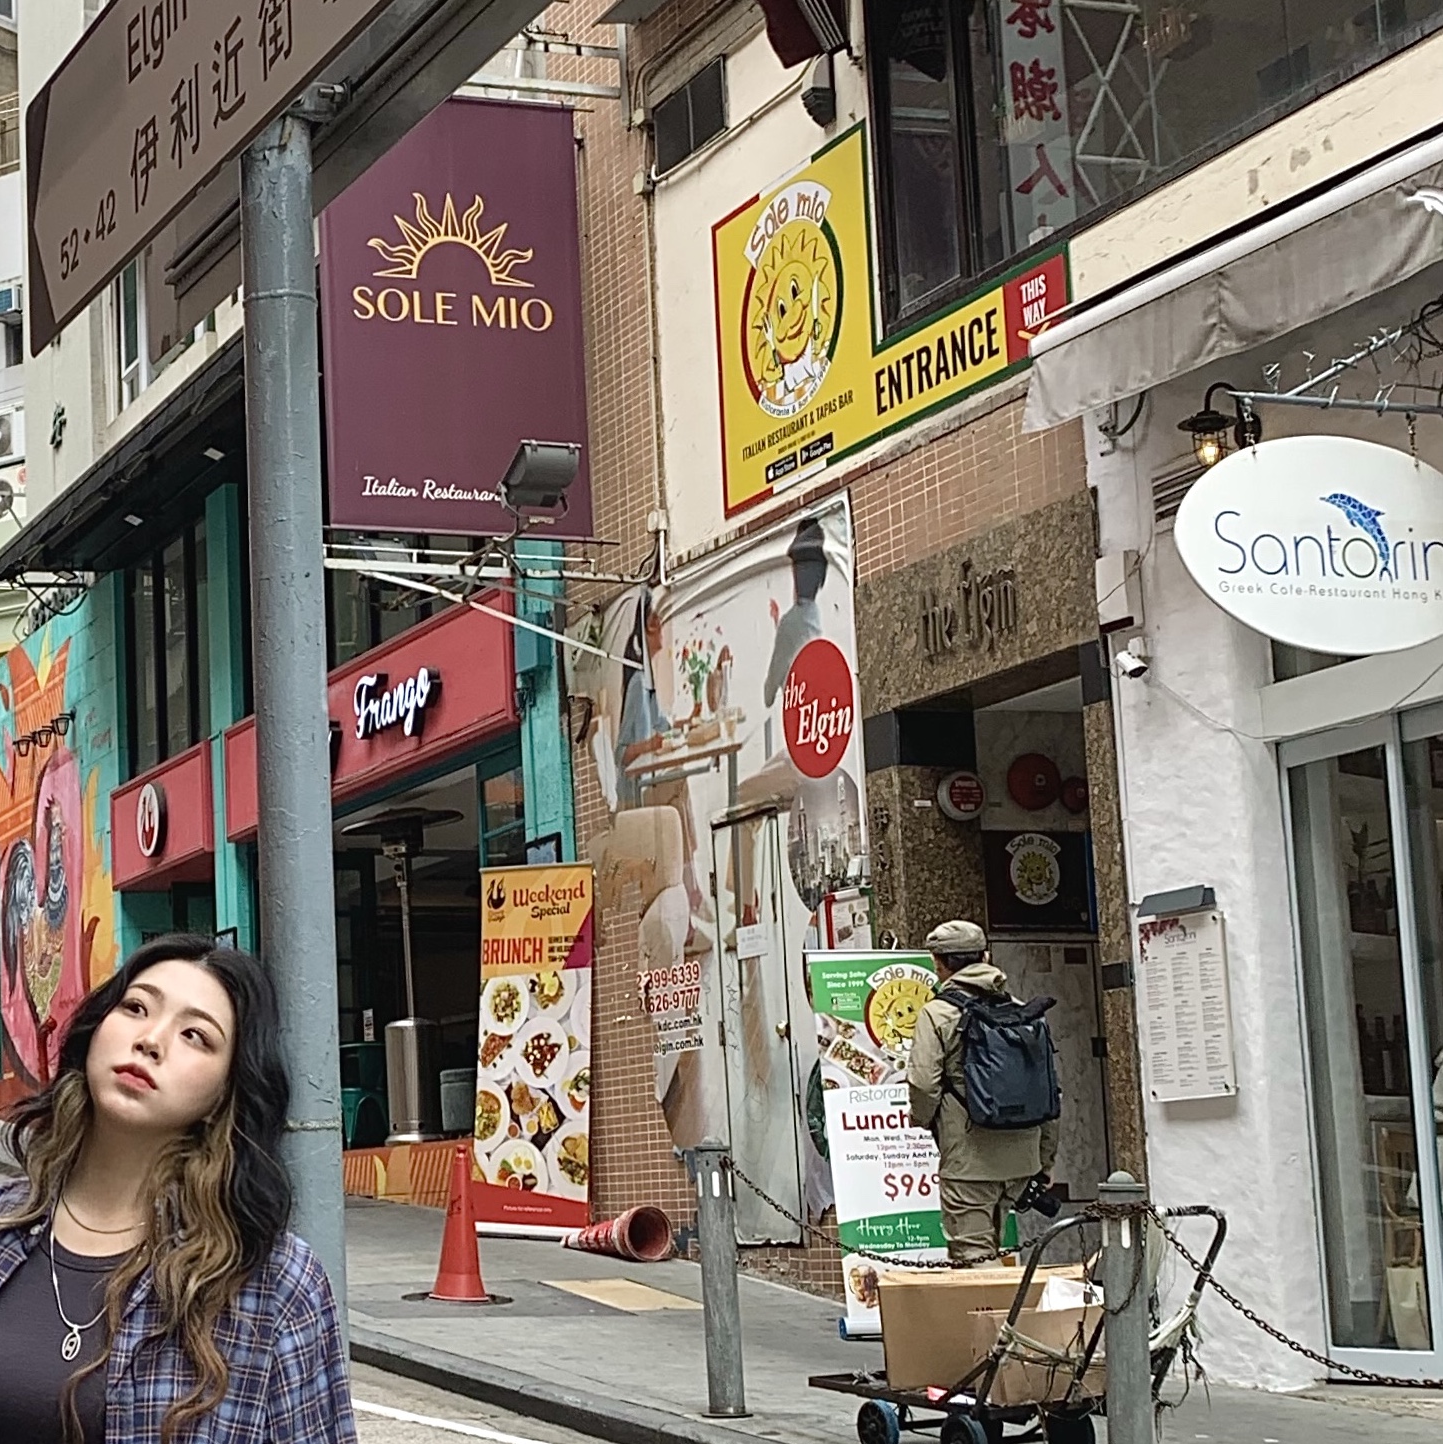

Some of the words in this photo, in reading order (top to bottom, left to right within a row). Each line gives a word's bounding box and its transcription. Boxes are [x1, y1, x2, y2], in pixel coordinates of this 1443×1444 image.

[130, 0, 293, 213] 伊利近街
[751, 198, 789, 266] Sole
[795, 191, 825, 223] mio
[1020, 274, 1046, 303] THIS
[353, 286, 458, 325] SOLE
[472, 295, 553, 331] MIO
[1023, 298, 1047, 328] WAY
[875, 308, 1000, 416] ENTRANCE
[742, 437, 766, 462] ITALIAN
[768, 414, 808, 448] RESTAURANT
[809, 410, 815, 425] &
[816, 401, 838, 421] TAPAS
[839, 389, 854, 410] BAR
[362, 476, 418, 497] Italian
[423, 480, 502, 502] Restauran
[1215, 511, 1443, 582] Santorin
[1219, 581, 1263, 594] Greek
[354, 667, 431, 741] Frango
[784, 671, 806, 710] the
[796, 698, 853, 754] Elgin
[1010, 834, 1034, 853] Sole
[513, 880, 586, 907] Weekend
[531, 902, 570, 920] Special
[483, 937, 543, 965] BRUNCH
[872, 967, 905, 988] Sole
[910, 968, 935, 987] mio
[849, 1088, 907, 1103] Ristoran
[842, 1109, 910, 1131] Lunch
[883, 1152, 910, 1160] Sunday
[856, 1216, 894, 1237] Happy
[859, 1242, 895, 1250] Wednesday
[905, 1241, 930, 1249] Monday
